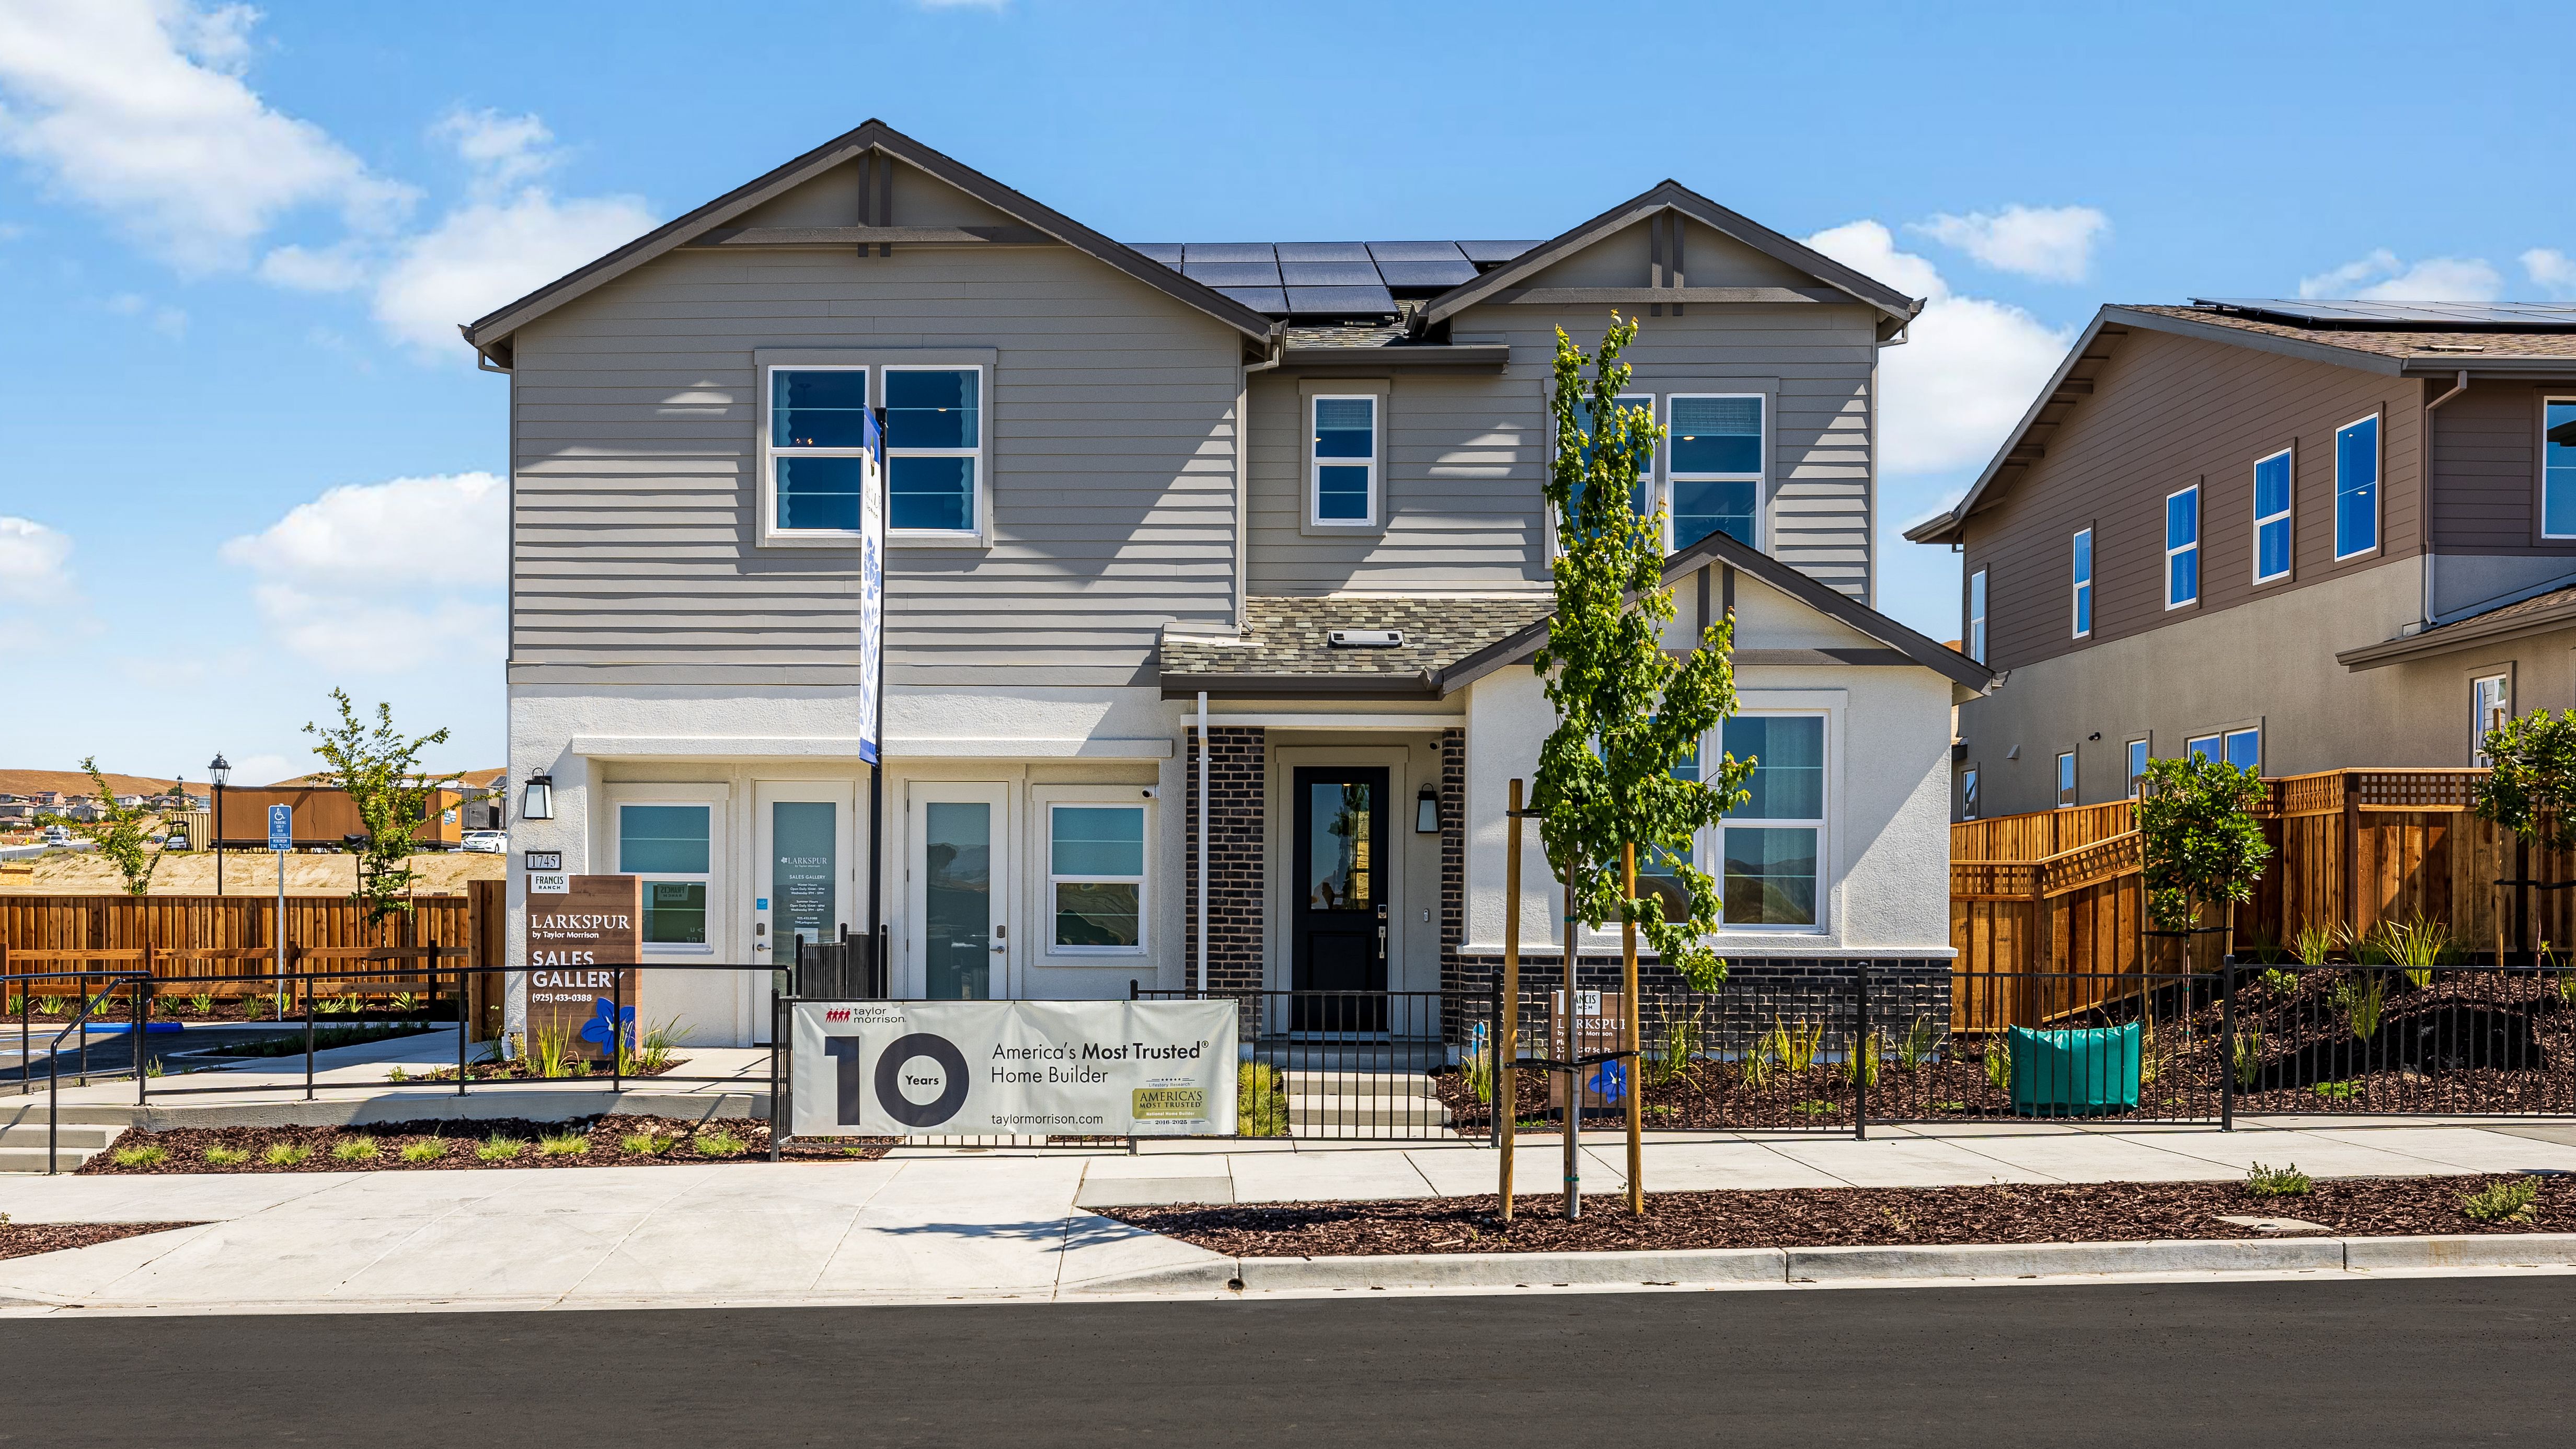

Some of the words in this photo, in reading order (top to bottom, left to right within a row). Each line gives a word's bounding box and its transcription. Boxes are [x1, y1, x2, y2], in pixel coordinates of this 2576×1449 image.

[532, 855, 556, 867] 1745
[536, 876, 564, 884] FRANCIS
[531, 915, 630, 929] LARKSPUR
[532, 931, 541, 939] by
[543, 931, 565, 939] Taylor
[532, 951, 594, 966] SALES
[532, 993, 553, 1003] (925)
[555, 994, 592, 1002] 433-0388
[854, 1007, 887, 1016] taylor
[1557, 1019, 1626, 1029] LRKSPU
[992, 1042, 1076, 1060] America's
[1082, 1043, 1128, 1059] Most
[824, 1032, 970, 1128] 10
[992, 1066, 1042, 1083] Home
[1049, 1065, 1108, 1083] Builder
[905, 1075, 939, 1086] Years
[1140, 1090, 1202, 1102] AMERICA'S
[992, 1114, 1103, 1126] taylormorrison.com
